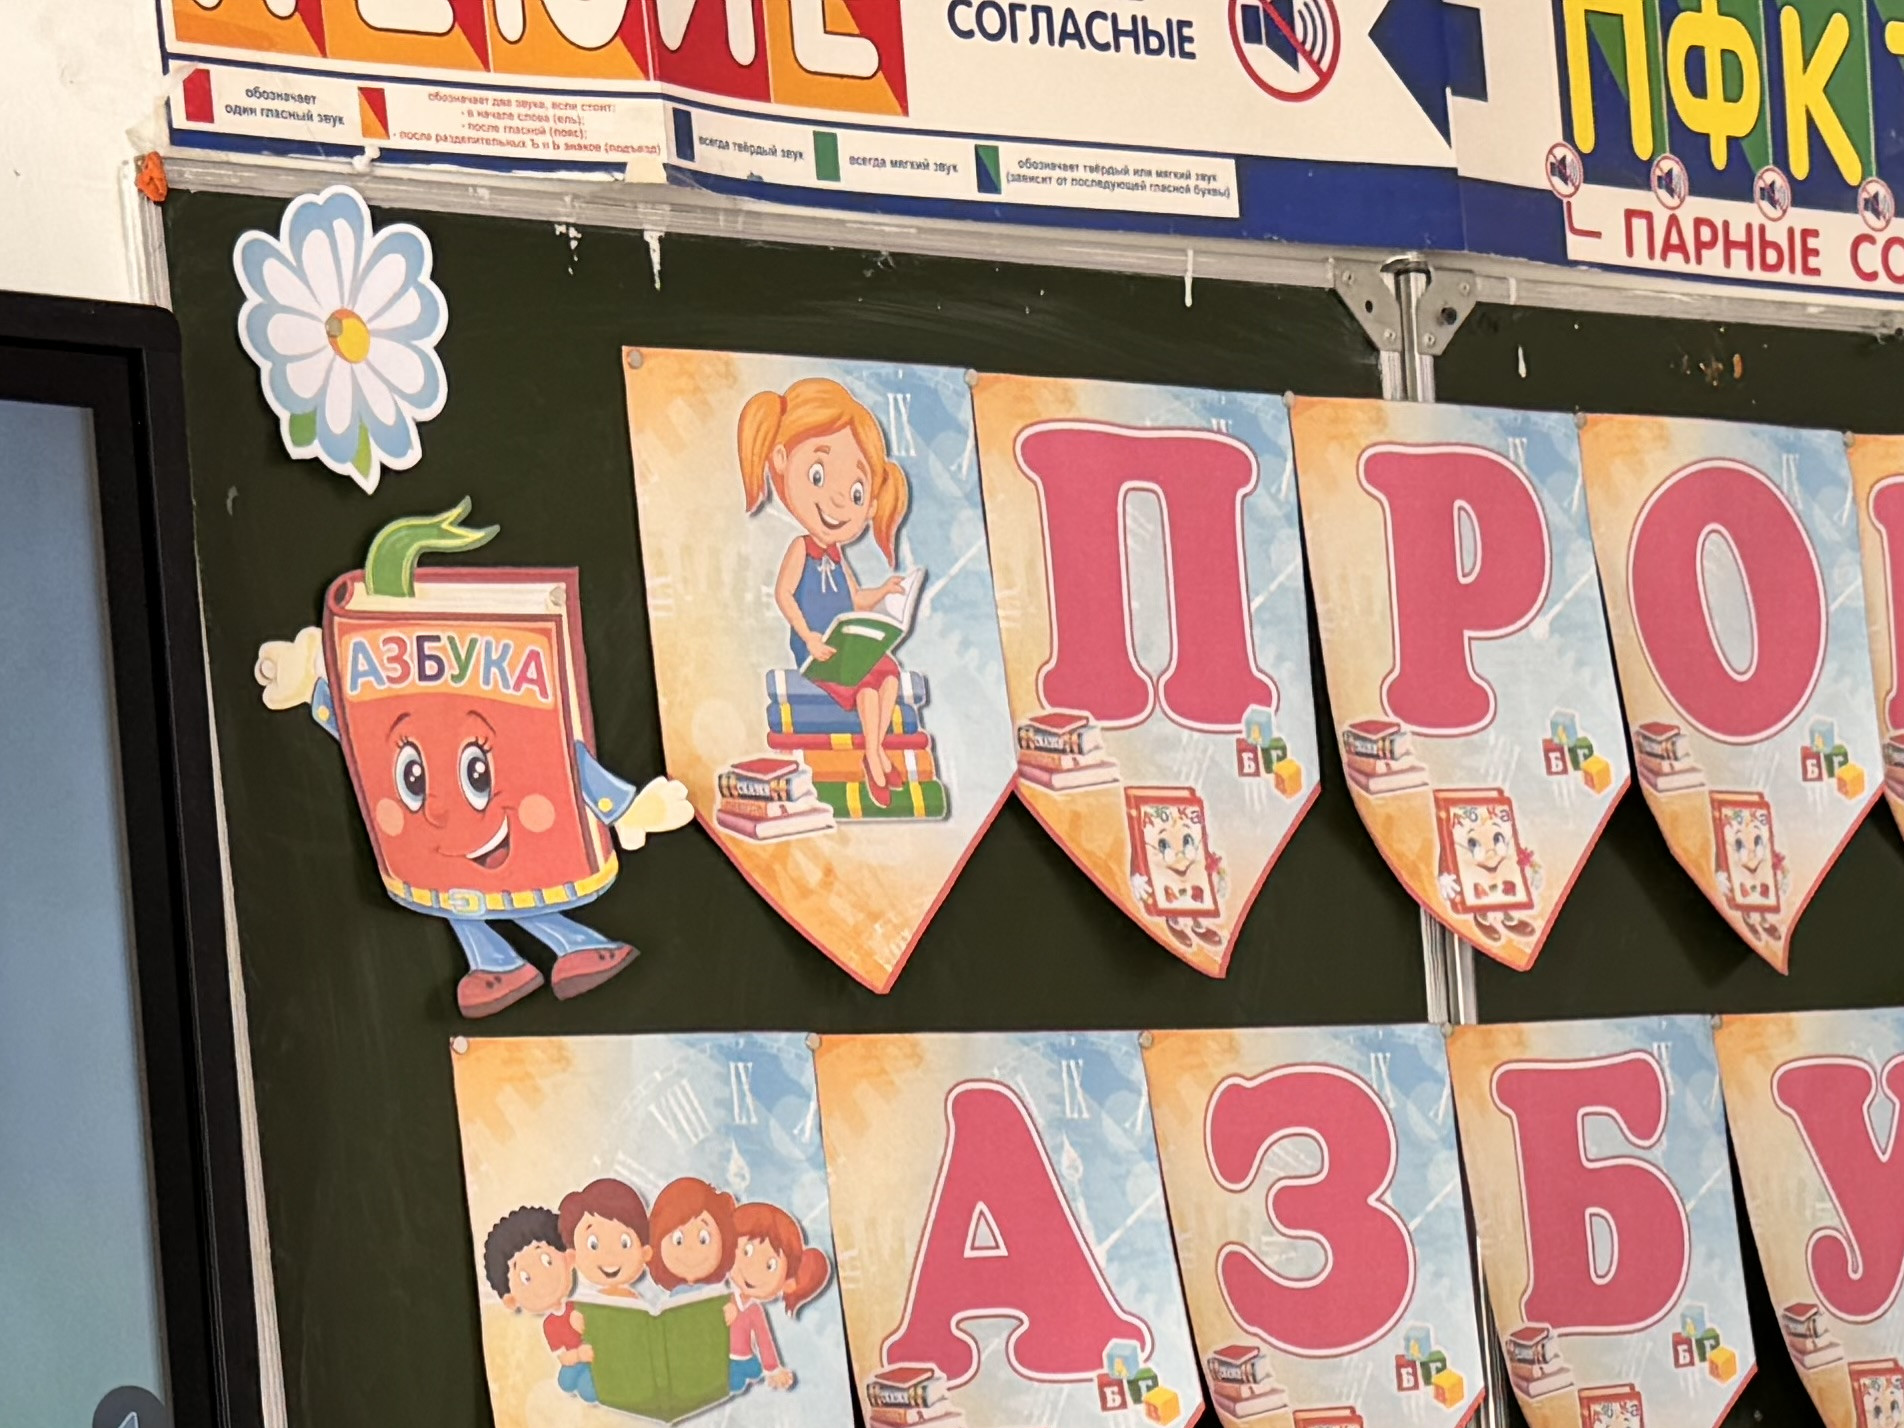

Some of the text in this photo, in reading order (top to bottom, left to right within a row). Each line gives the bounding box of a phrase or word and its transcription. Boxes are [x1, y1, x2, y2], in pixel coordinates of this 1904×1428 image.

[948, 0, 1197, 60] СОГЛАСНЫЕ
[245, 86, 316, 105] обозначает
[428, 92, 489, 105] обозначает
[224, 104, 345, 128] один гласный звук
[699, 135, 804, 162] всегда твёрдый звук
[849, 153, 959, 176] всегда мягкий звук
[1018, 158, 1079, 173] обозначает
[1083, 163, 1129, 177] твёрдый
[1155, 168, 1192, 181] мягкий
[1195, 172, 1217, 185] звук
[1056, 176, 1068, 187] от
[1624, 208, 1821, 277] ПАРНЫЕ
[346, 632, 553, 703] АЗБУКА
